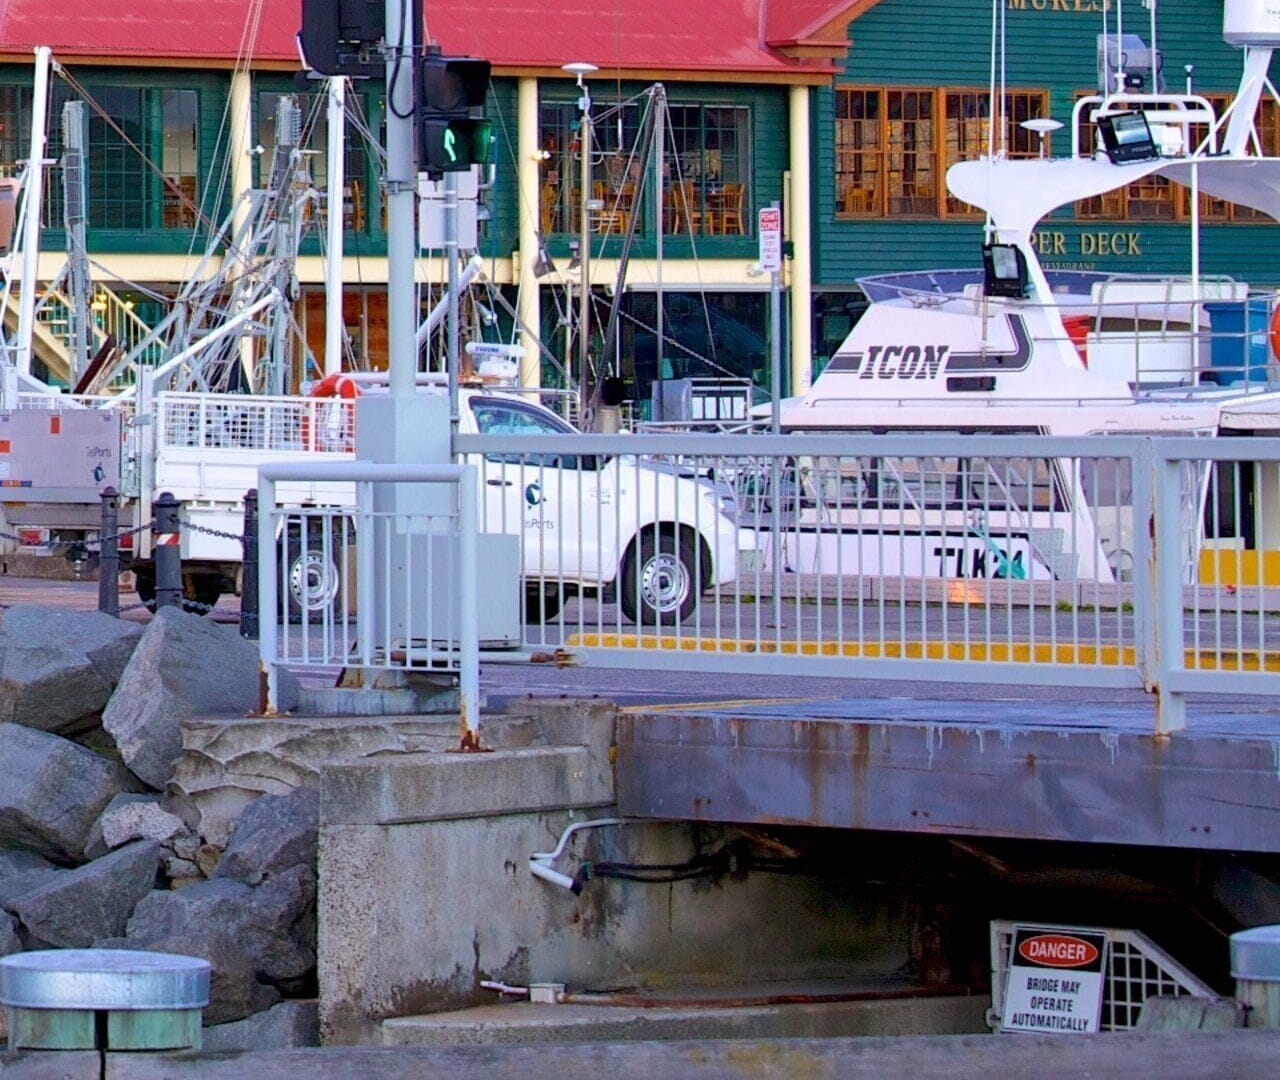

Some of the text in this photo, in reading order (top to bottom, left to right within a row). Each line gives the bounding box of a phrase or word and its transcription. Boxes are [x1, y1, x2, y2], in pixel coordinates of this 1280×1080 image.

[1081, 232, 1143, 256] DECK
[859, 345, 950, 379] ICON
[86, 446, 112, 458] TasPorts
[1029, 941, 1087, 961] DANGER
[1026, 977, 1082, 995] BRIDGE MAY
[1030, 995, 1073, 1013] OPERATE
[1011, 1012, 1089, 1032] AUTOMATICALLY
